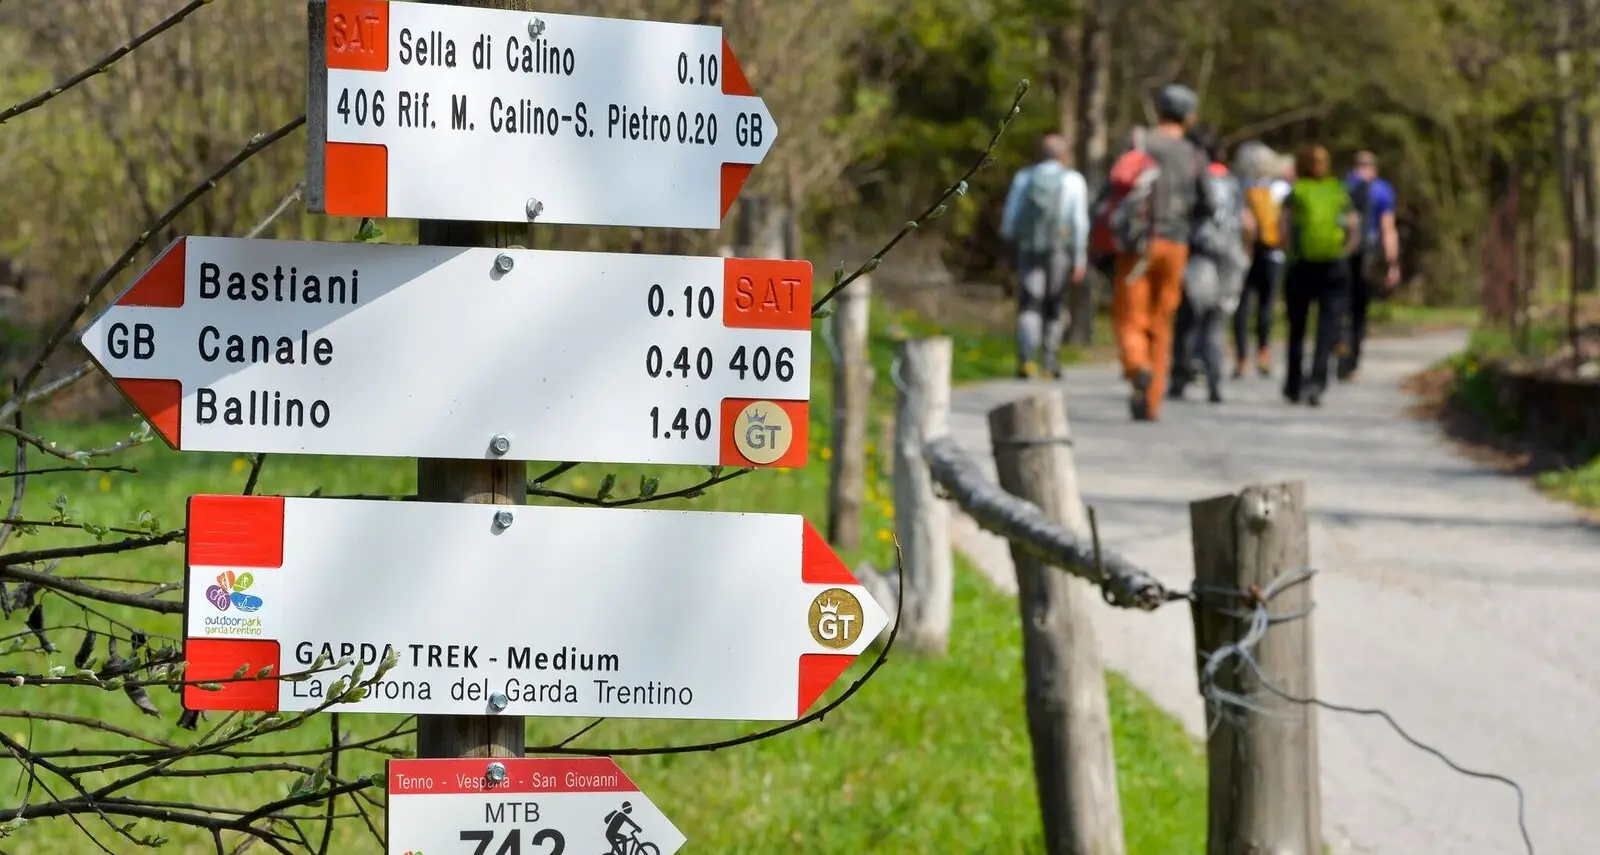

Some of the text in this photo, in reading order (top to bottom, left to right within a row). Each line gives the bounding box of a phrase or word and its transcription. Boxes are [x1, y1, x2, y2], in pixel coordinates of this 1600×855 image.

[332, 13, 380, 54] SAT
[400, 28, 717, 86] Sella di Calino 0.10
[338, 88, 762, 146] 406 Rif. M. Calino-S. Pietro 0.20 GB
[200, 262, 801, 318] Bastiani 0.10 SAT
[108, 323, 793, 382] GB Canale 0.40 406
[197, 388, 711, 440] Ballino 1.40
[745, 425, 782, 449] GT
[819, 614, 855, 640] GT
[409, 645, 478, 668] TREK
[508, 647, 618, 671] Medium
[293, 681, 323, 699] La
[450, 677, 488, 700] del
[505, 677, 579, 705] Garda
[594, 680, 692, 705] Trentino
[396, 774, 434, 790] Tenno
[532, 772, 557, 788] San
[565, 771, 618, 787] Giovanni
[486, 803, 539, 822] MTB
